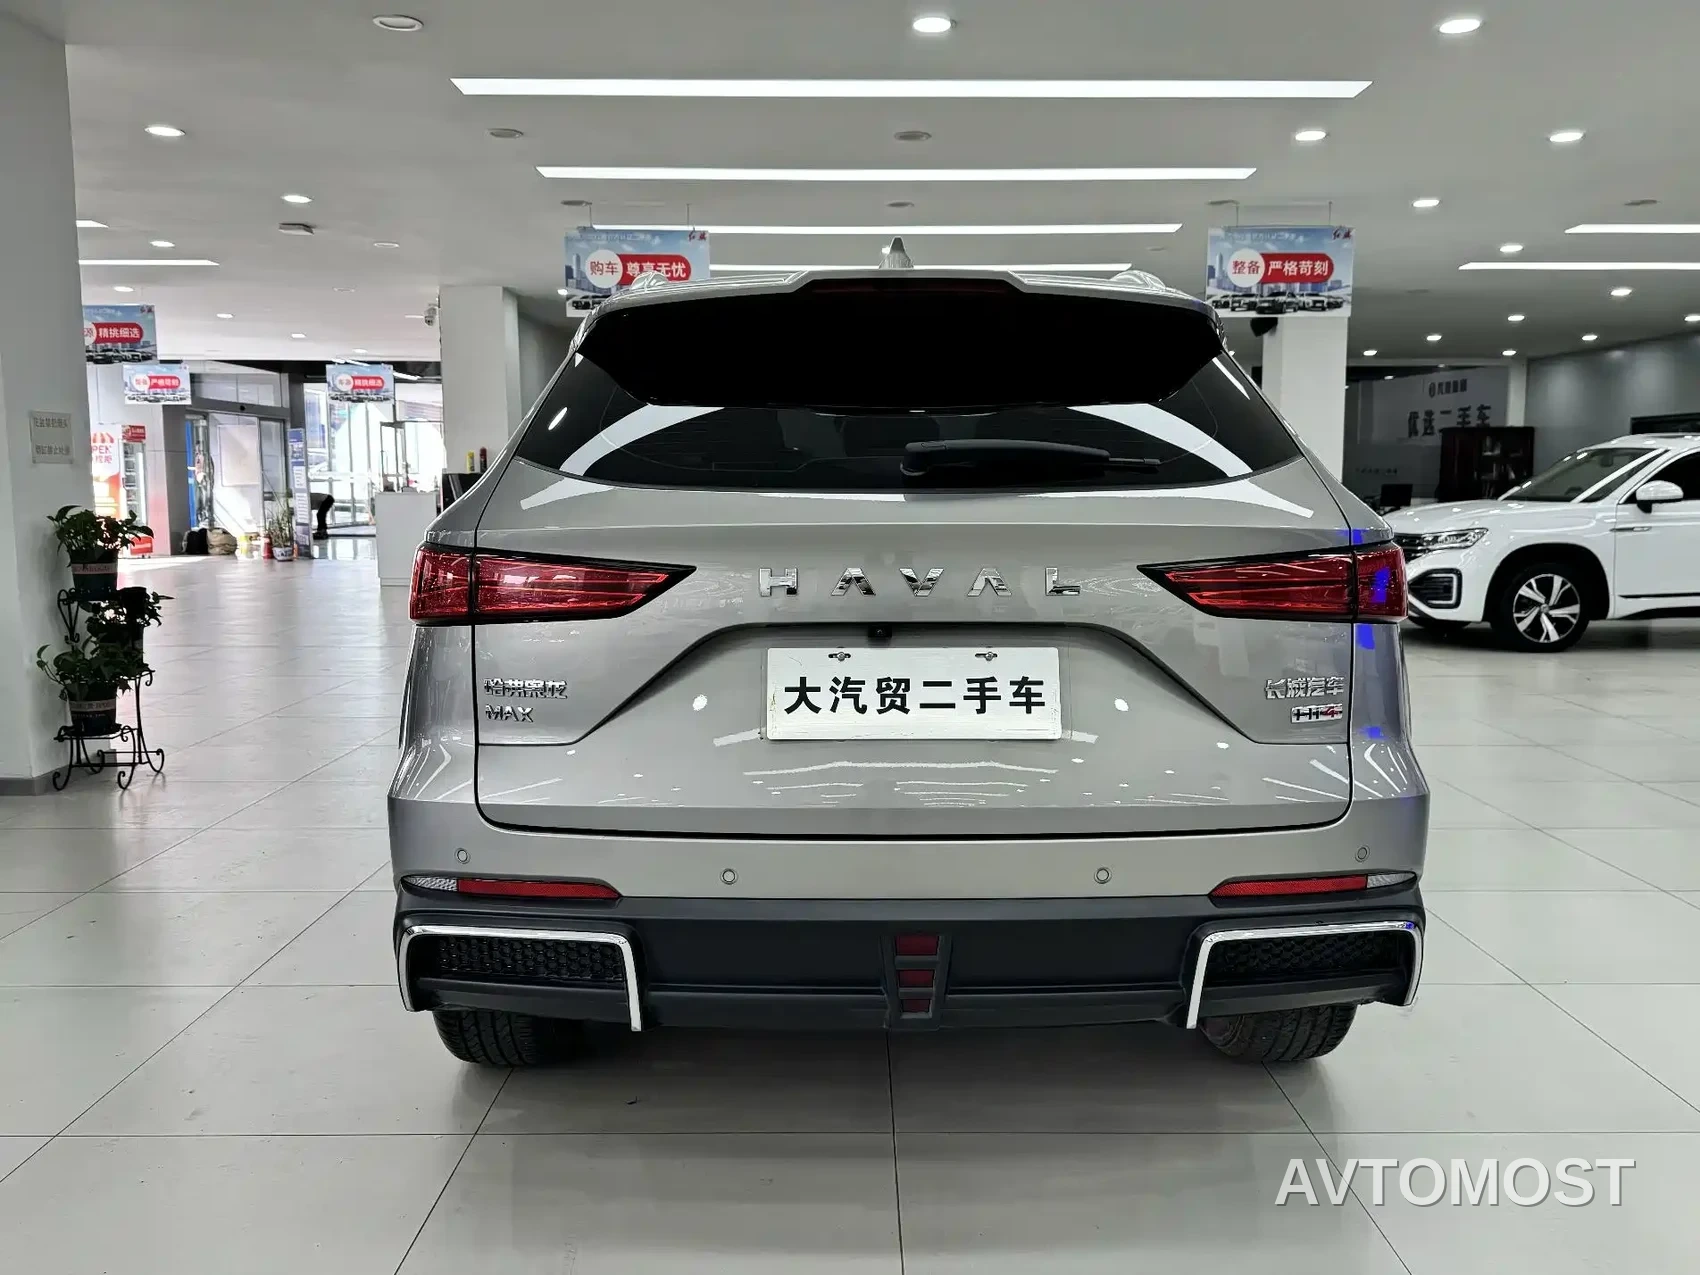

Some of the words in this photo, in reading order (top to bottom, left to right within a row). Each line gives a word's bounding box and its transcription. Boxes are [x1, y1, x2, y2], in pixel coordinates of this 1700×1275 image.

[590, 261, 619, 275] 购车
[627, 261, 687, 278] 尊享无忧
[1232, 260, 1260, 275] 整备
[1268, 260, 1329, 276] 严格苛刻
[99, 327, 140, 338] 精挑细选
[759, 567, 1081, 596] HAVAL
[784, 676, 1046, 715] 大汽贸二手车
[1265, 676, 1344, 699] 长城汽车
[485, 703, 534, 723] MAX
